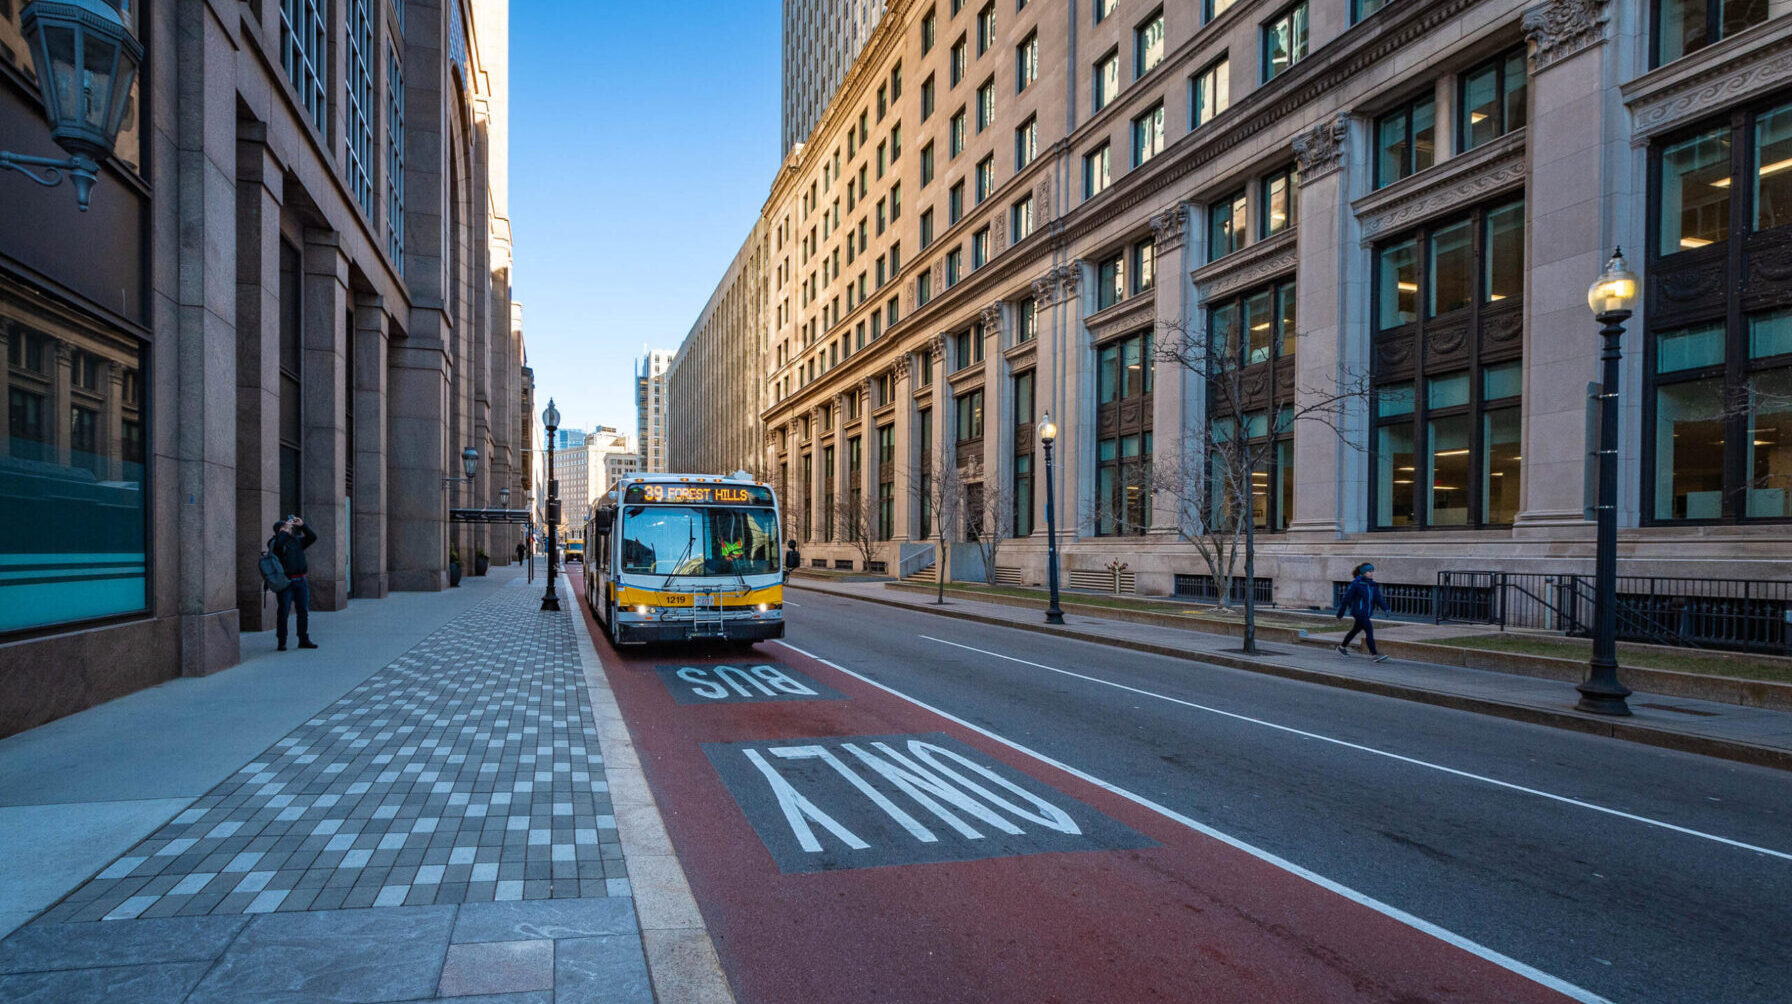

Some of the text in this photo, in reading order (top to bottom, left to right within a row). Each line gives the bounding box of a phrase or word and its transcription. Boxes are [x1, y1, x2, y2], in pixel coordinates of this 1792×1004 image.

[644, 485, 748, 502] 39 FOREST HILLS
[666, 596, 686, 604] 1219
[676, 665, 818, 699] BUS
[742, 739, 1082, 853] ONLY
